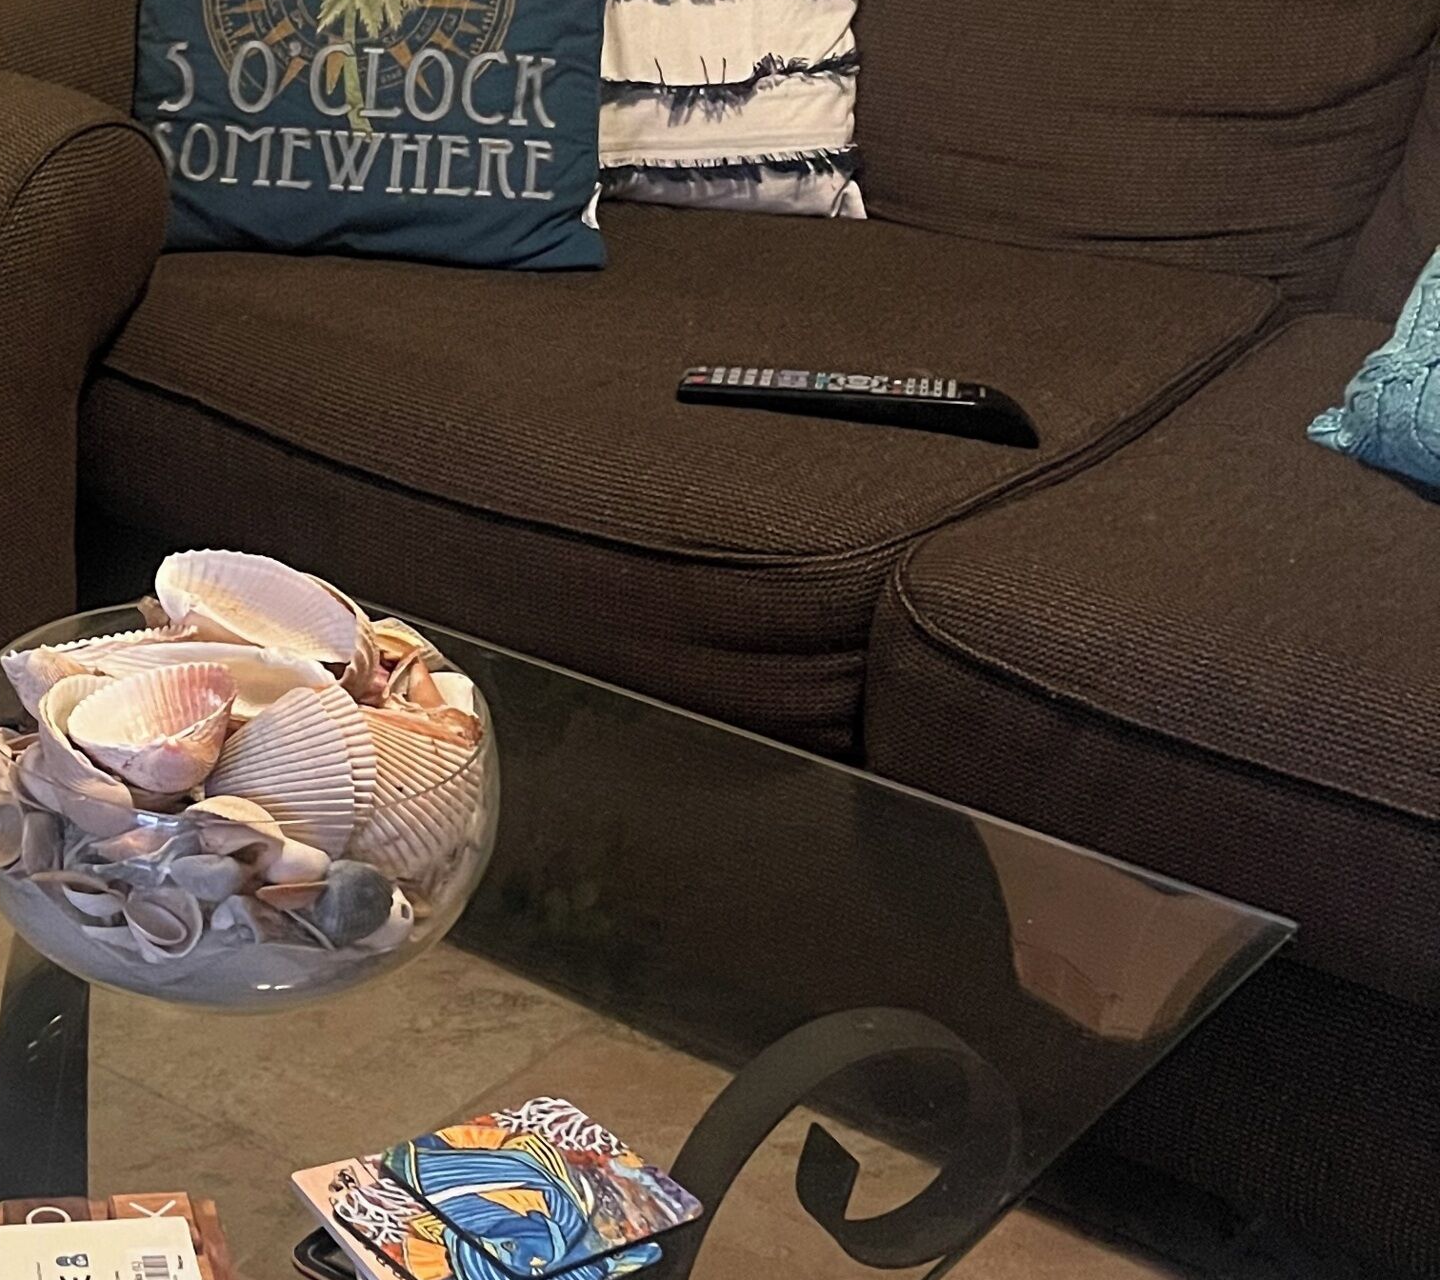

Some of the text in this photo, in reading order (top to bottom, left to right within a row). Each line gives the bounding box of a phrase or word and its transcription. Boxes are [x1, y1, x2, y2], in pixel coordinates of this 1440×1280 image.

[158, 40, 556, 129] 5 O'CLOCK
[152, 122, 554, 201] SOMEWHERE
